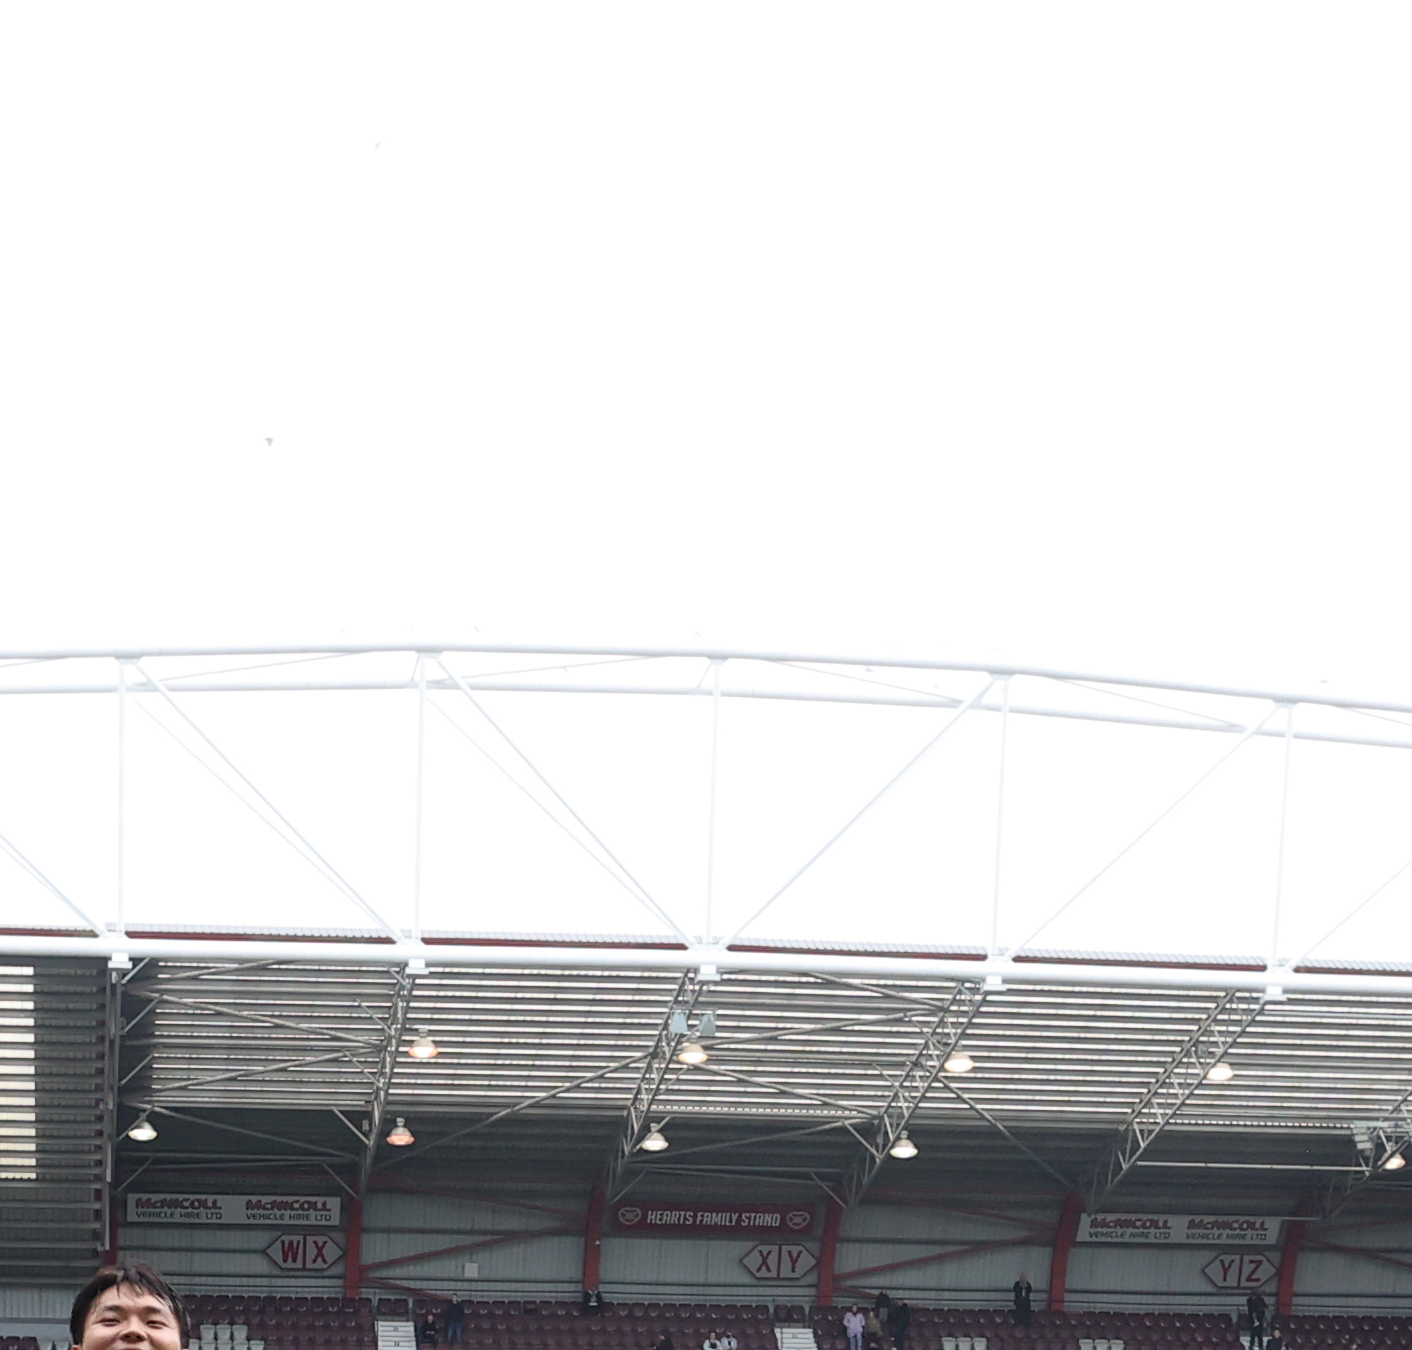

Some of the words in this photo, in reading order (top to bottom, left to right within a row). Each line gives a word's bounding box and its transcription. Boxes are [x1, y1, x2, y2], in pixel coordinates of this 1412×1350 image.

[136, 1211, 175, 1220] VEHICLE
[179, 1211, 200, 1220] HIRE
[205, 1211, 223, 1220] LTD
[246, 1213, 285, 1221] VEHICLE
[289, 1213, 311, 1221] HIRE
[315, 1213, 332, 1222] LTD
[647, 1210, 693, 1225] HEARTS
[696, 1212, 738, 1226] FAMILY
[740, 1213, 781, 1227] STAND
[1089, 1231, 1126, 1239] VEHICLE
[1129, 1231, 1150, 1239] HIRE
[1153, 1231, 1171, 1240] LTD
[1186, 1232, 1222, 1240] VEHICLE
[1250, 1233, 1267, 1241] LTD
[280, 1239, 301, 1264] W
[311, 1240, 329, 1264] X
[756, 1249, 773, 1273] X
[786, 1249, 803, 1273] Y
[1219, 1258, 1235, 1282] Y
[1245, 1260, 1263, 1283] Z
